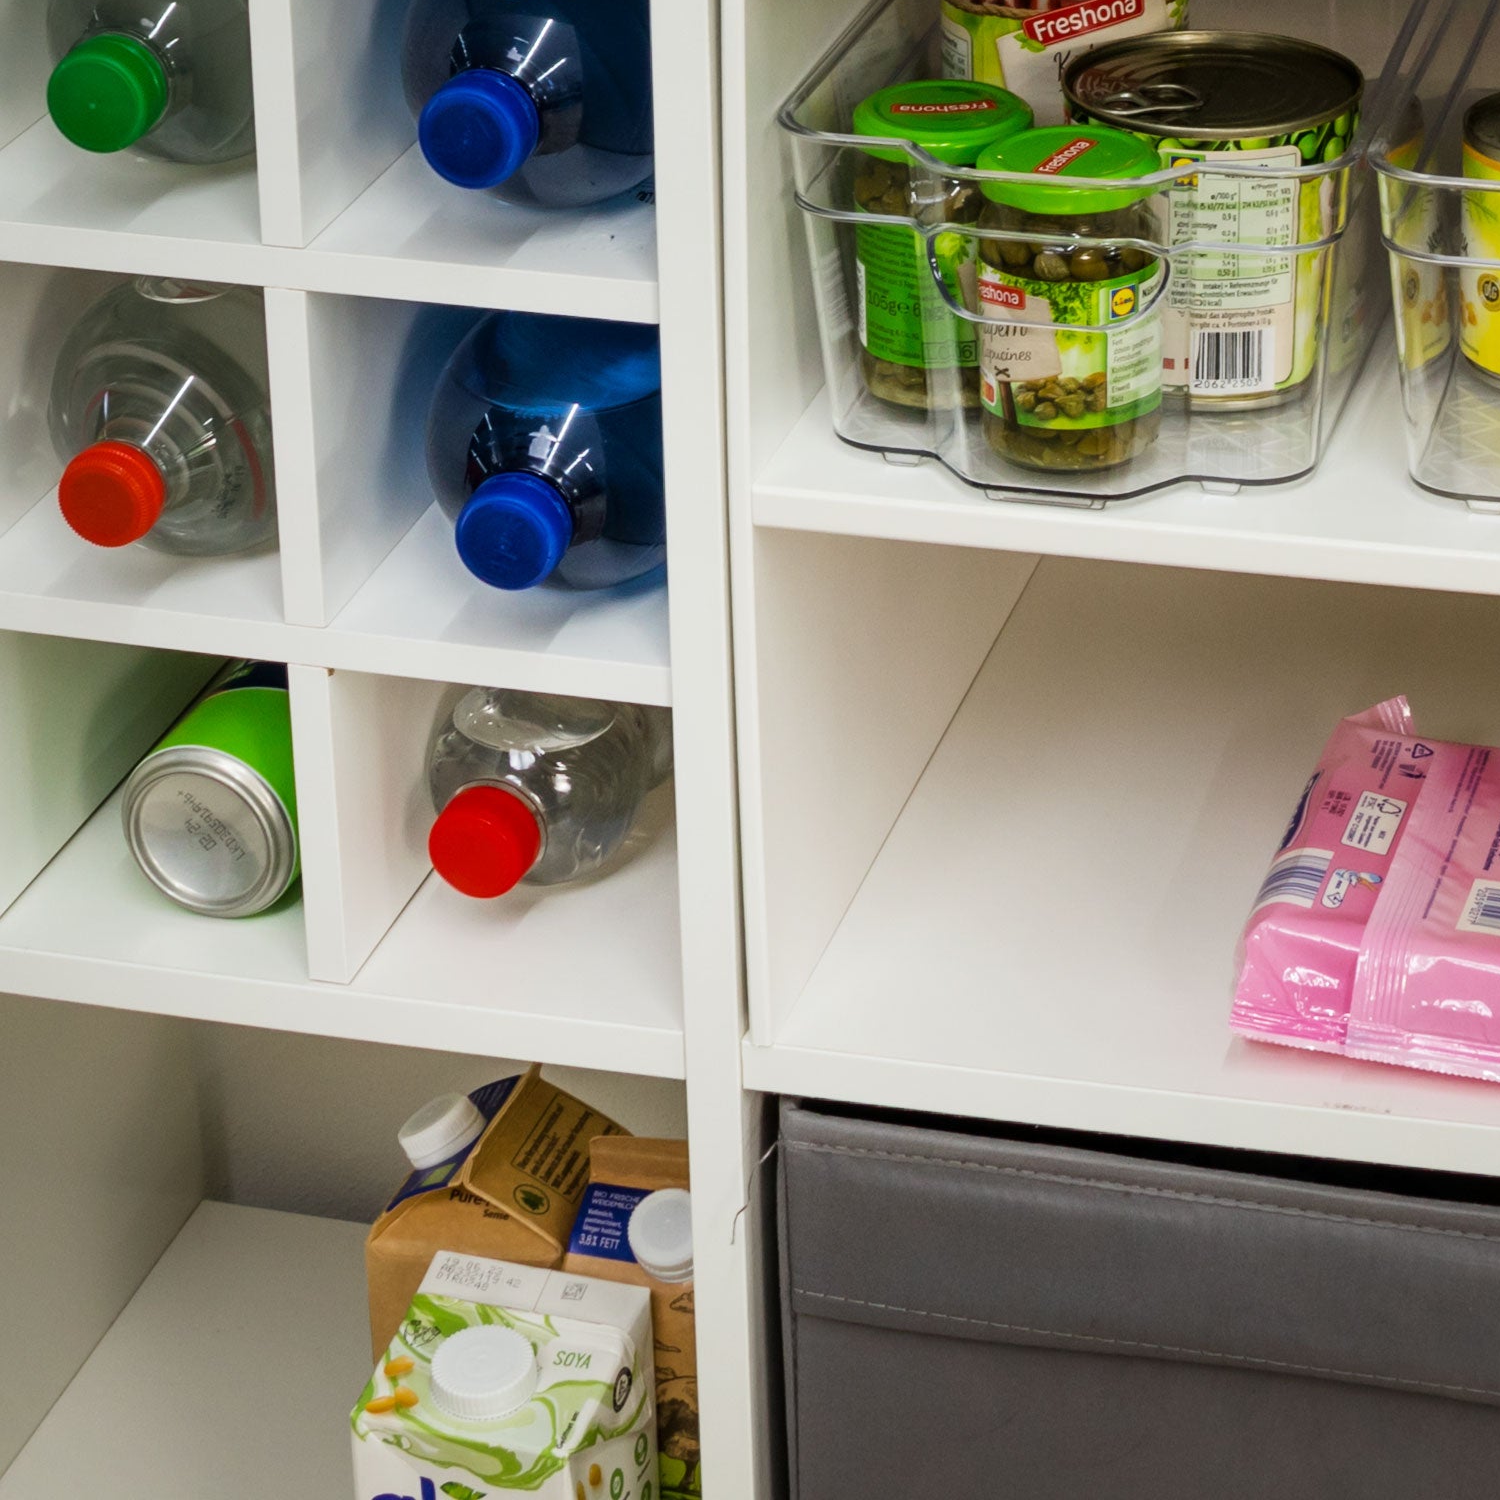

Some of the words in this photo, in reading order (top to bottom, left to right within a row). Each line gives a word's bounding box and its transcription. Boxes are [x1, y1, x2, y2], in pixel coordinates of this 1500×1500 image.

[899, 100, 990, 113] Freshona
[1037, 139, 1091, 175] Freshona
[1193, 380, 1227, 390] 2062
[599, 1236, 621, 1250] FETT
[553, 1349, 593, 1370] SOYA
